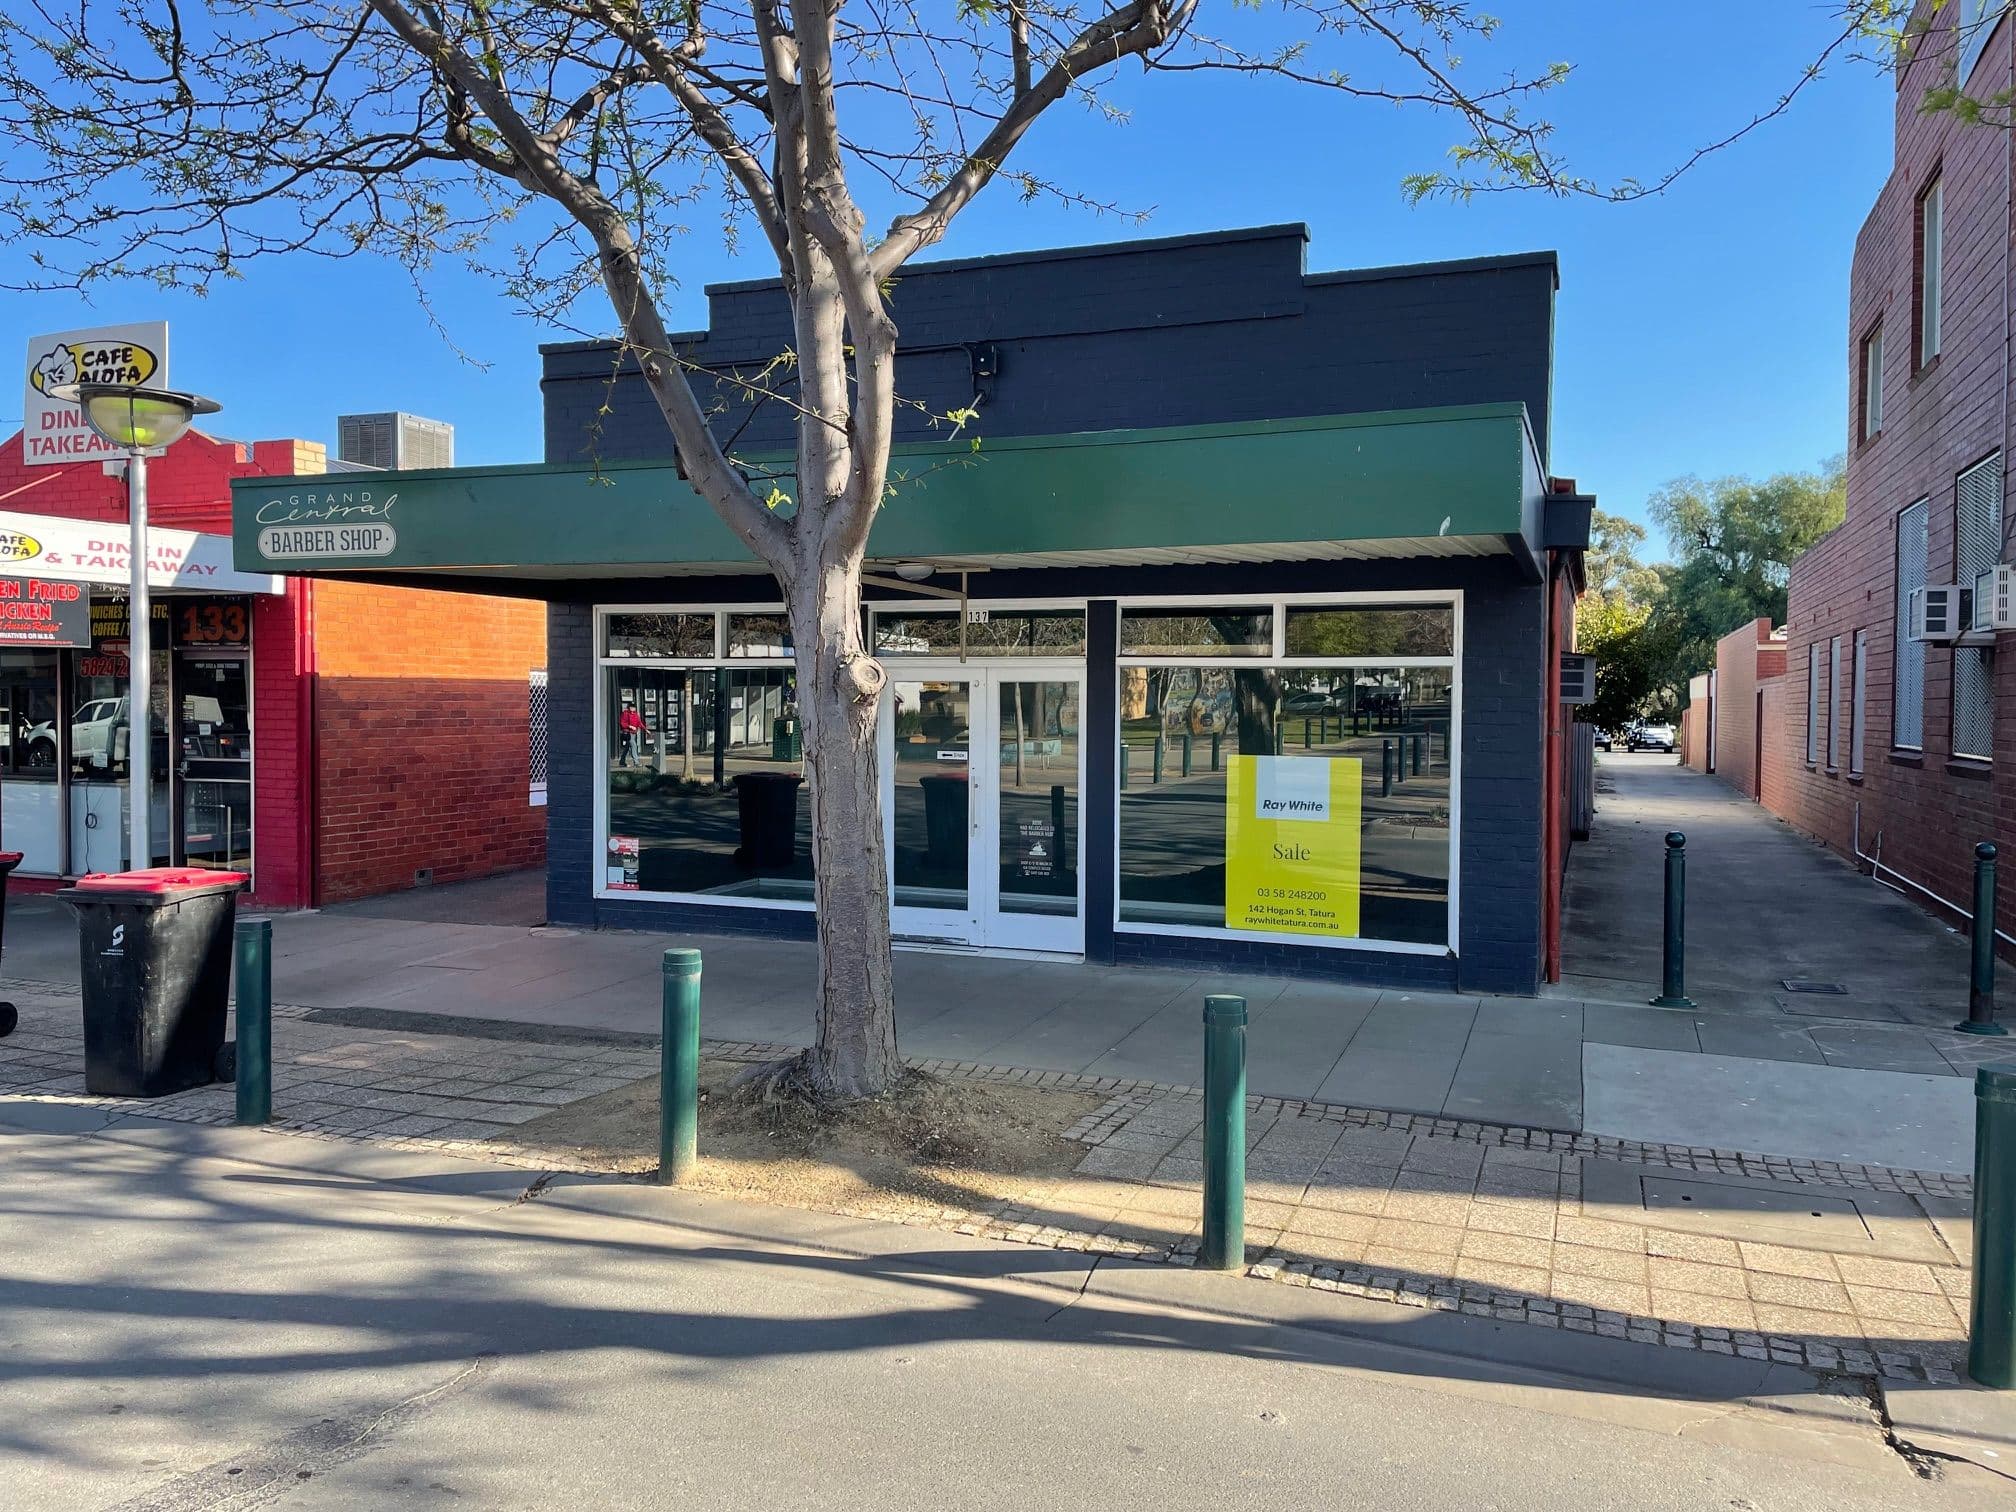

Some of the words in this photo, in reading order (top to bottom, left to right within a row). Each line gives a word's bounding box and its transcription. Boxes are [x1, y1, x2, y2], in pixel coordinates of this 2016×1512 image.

[81, 347, 133, 367] CAFE
[79, 365, 141, 383] ALOFA
[29, 433, 120, 456] TAKEAW
[289, 492, 372, 505] GRAND
[256, 493, 399, 524] Central
[0, 535, 27, 546] AFE
[88, 540, 149, 556] DIN
[157, 547, 182, 558] IN
[271, 530, 335, 553] BARBER
[340, 529, 382, 551] SHOP
[0, 545, 31, 557] OFA
[45, 552, 63, 564] &
[71, 553, 218, 576] TAKAWAY
[0, 580, 20, 599] EN
[28, 578, 80, 602] FRIED
[0, 602, 52, 620] ICKEN
[90, 604, 124, 619] WICHES
[968, 611, 988, 622] 137
[92, 621, 120, 636] COFFEE
[182, 604, 247, 642] 133
[1262, 799, 1287, 812] Ray
[1289, 800, 1323, 812] White
[1273, 843, 1311, 861] Sale
[1257, 887, 1270, 898] 03
[1273, 888, 1286, 899] 58
[1288, 889, 1327, 901] 248200
[1248, 904, 1265, 914] 142
[1266, 905, 1294, 916] Hogan
[1309, 908, 1336, 919] Tatura
[1244, 916, 1339, 930] raywhitetatura.com.au
